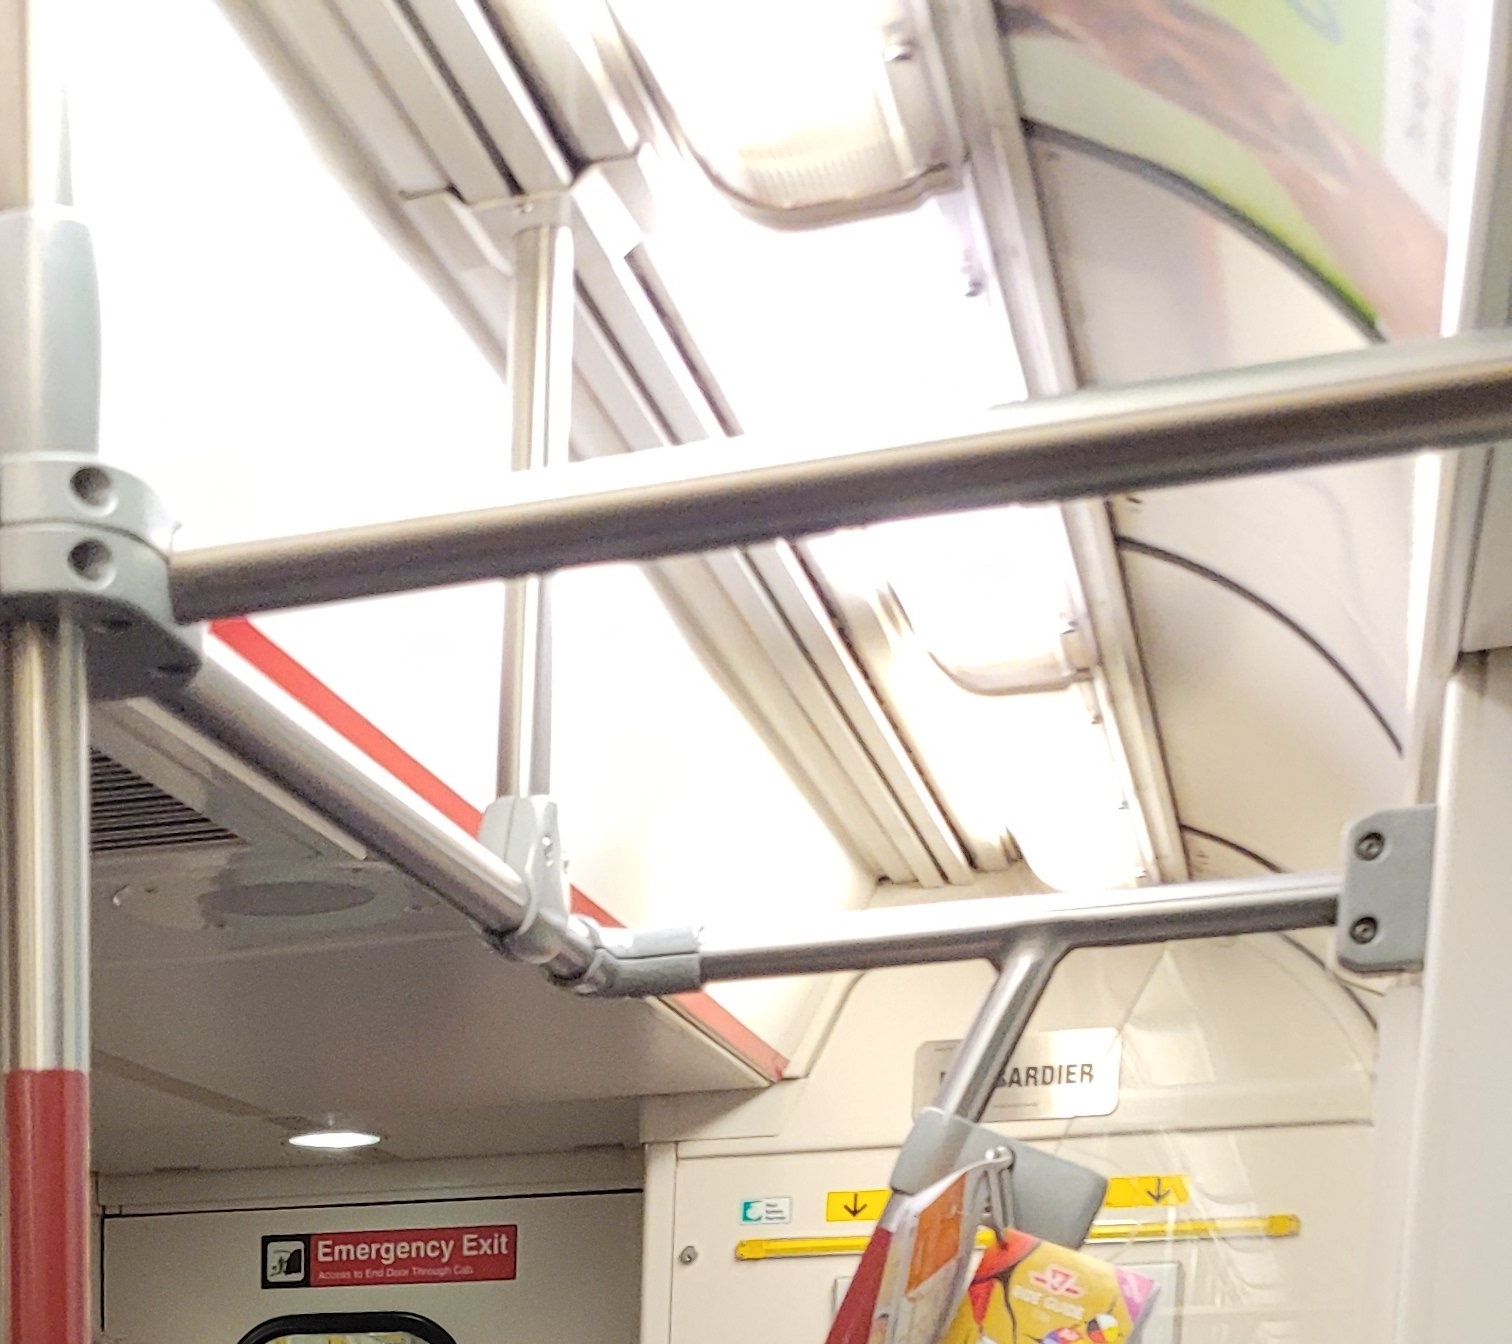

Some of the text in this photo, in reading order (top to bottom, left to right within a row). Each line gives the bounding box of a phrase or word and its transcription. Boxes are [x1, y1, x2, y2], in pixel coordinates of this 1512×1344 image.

[317, 1232, 509, 1266] Emergency Exit
[353, 1270, 363, 1279] to
[365, 1268, 384, 1278] End
